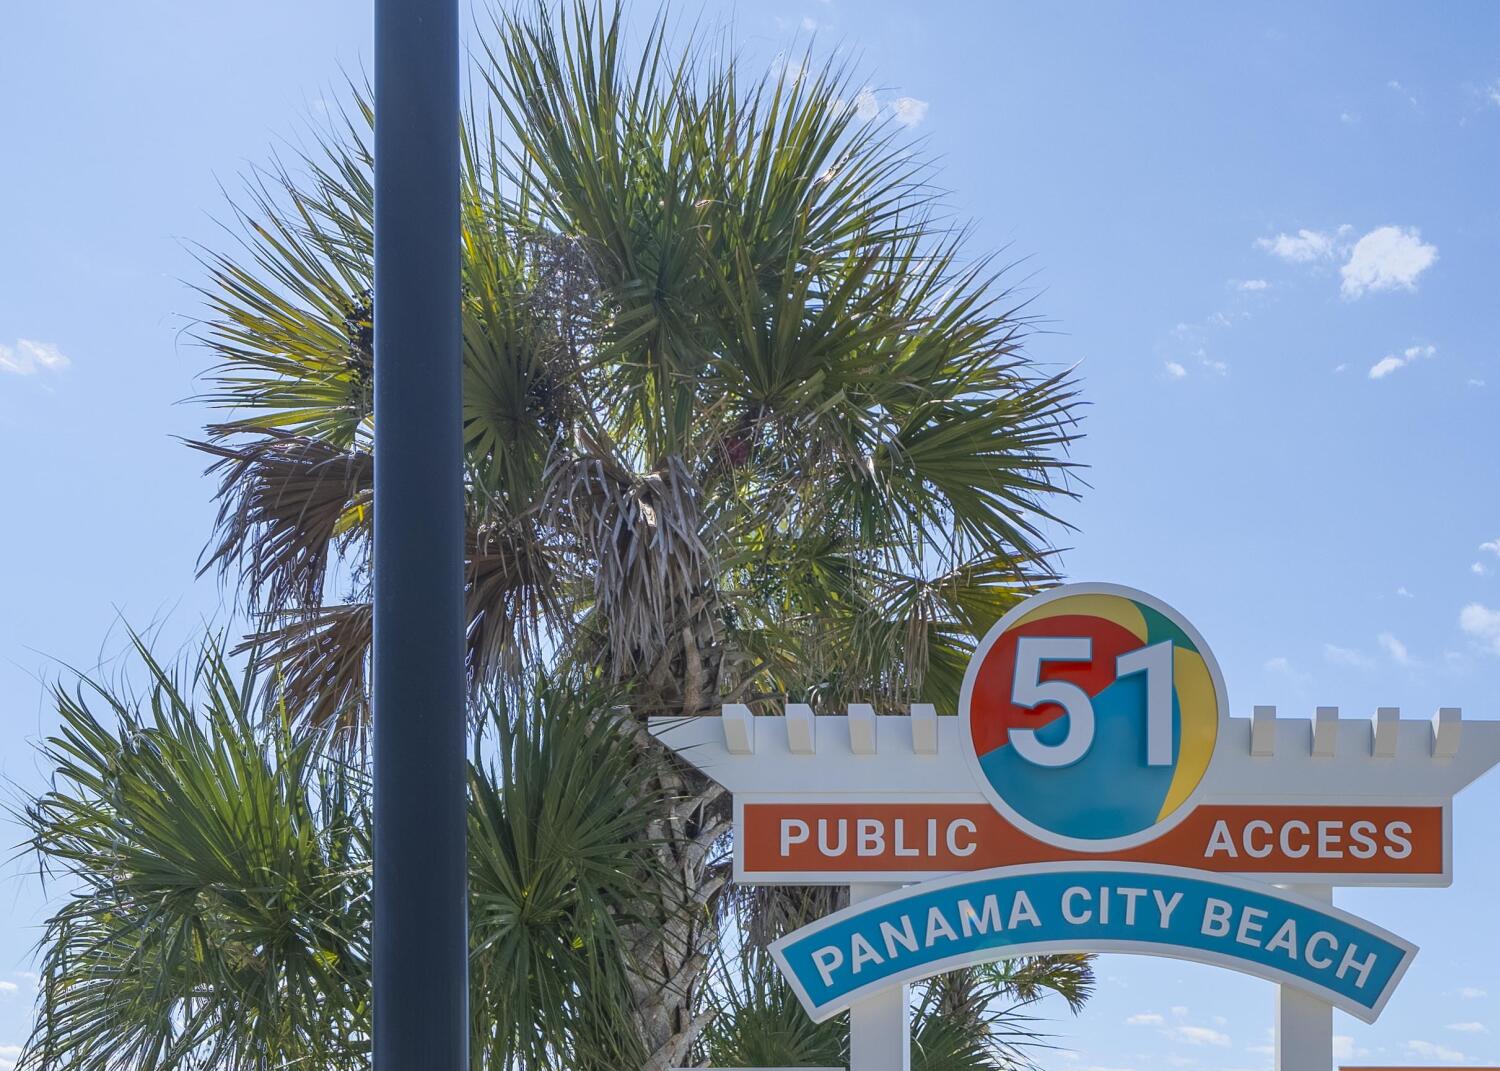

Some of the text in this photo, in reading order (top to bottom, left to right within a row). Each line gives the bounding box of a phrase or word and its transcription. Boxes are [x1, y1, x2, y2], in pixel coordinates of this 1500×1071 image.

[1007, 636, 1175, 768] 51
[778, 818, 1414, 860] PUBLIC ACCESS
[811, 886, 1378, 989] PANAMA CITY BEACH
